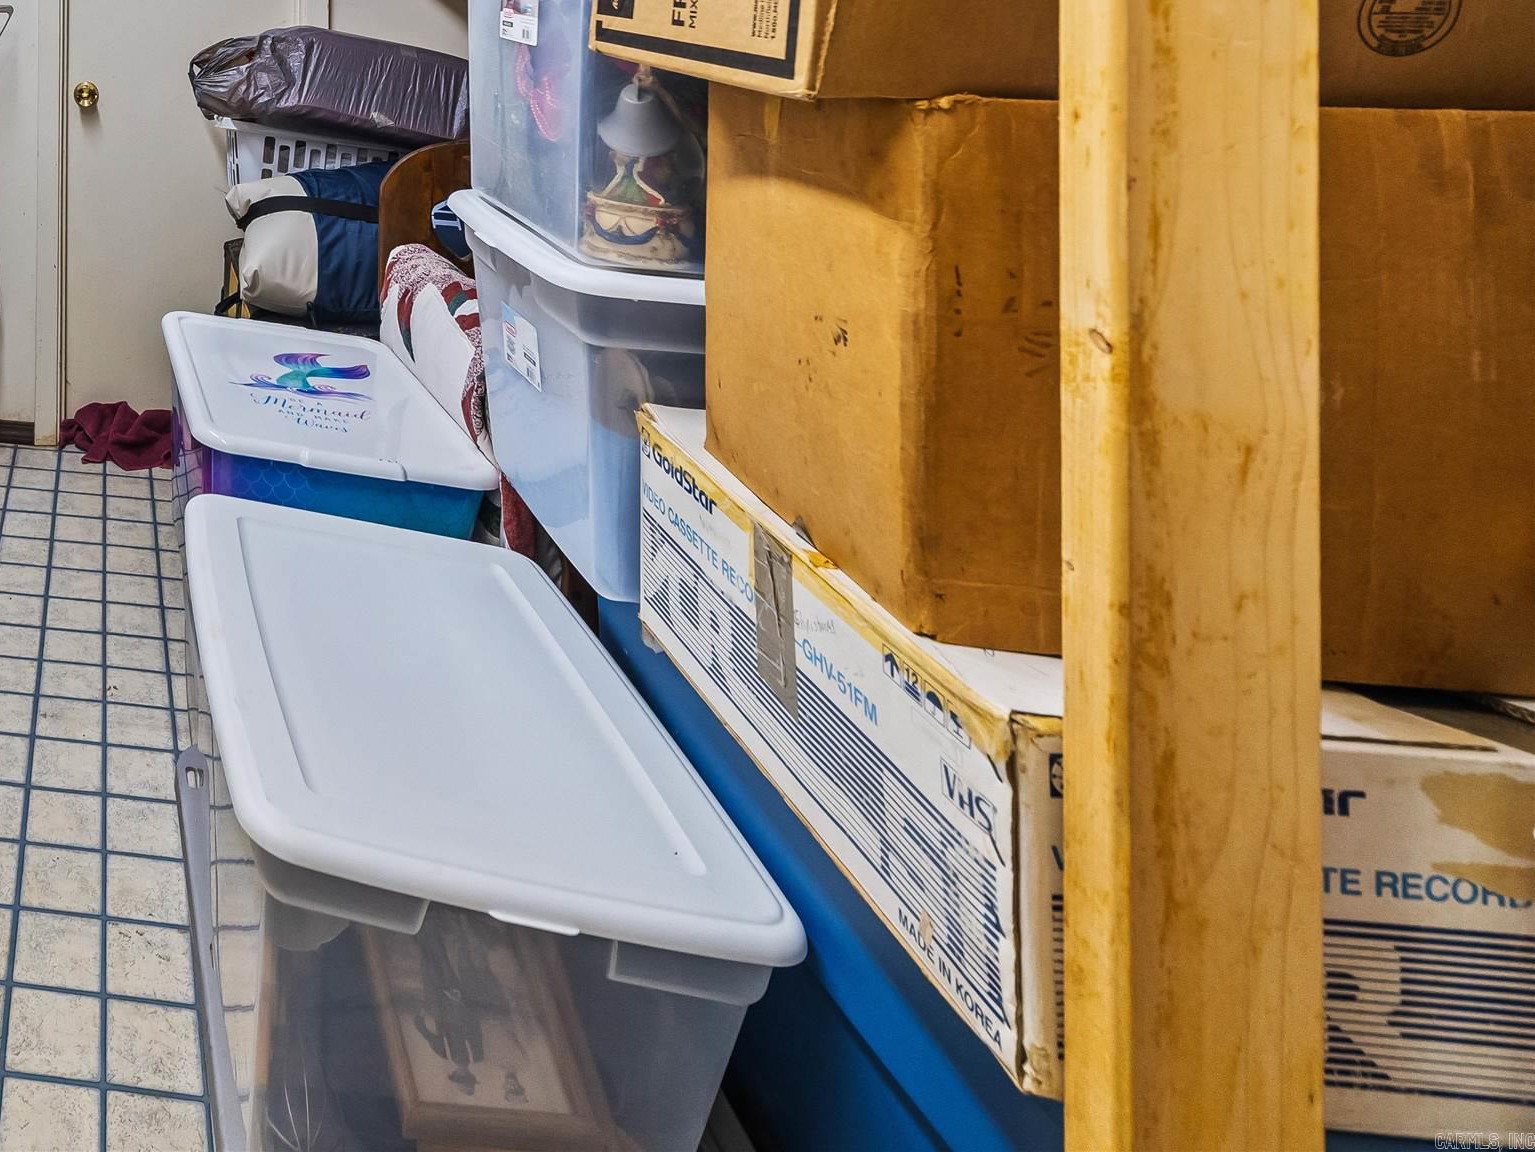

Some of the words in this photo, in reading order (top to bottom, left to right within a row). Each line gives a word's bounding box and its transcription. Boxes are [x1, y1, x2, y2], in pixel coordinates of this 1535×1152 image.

[250, 392, 372, 421] Mermaid
[650, 444, 718, 516] GoldStar
[642, 479, 666, 516] VIDEO
[667, 506, 719, 571] CASSETTE
[943, 763, 997, 833] VHS
[898, 907, 935, 965] MADE
[938, 956, 952, 985] IN
[955, 977, 1003, 1053] KOREA
